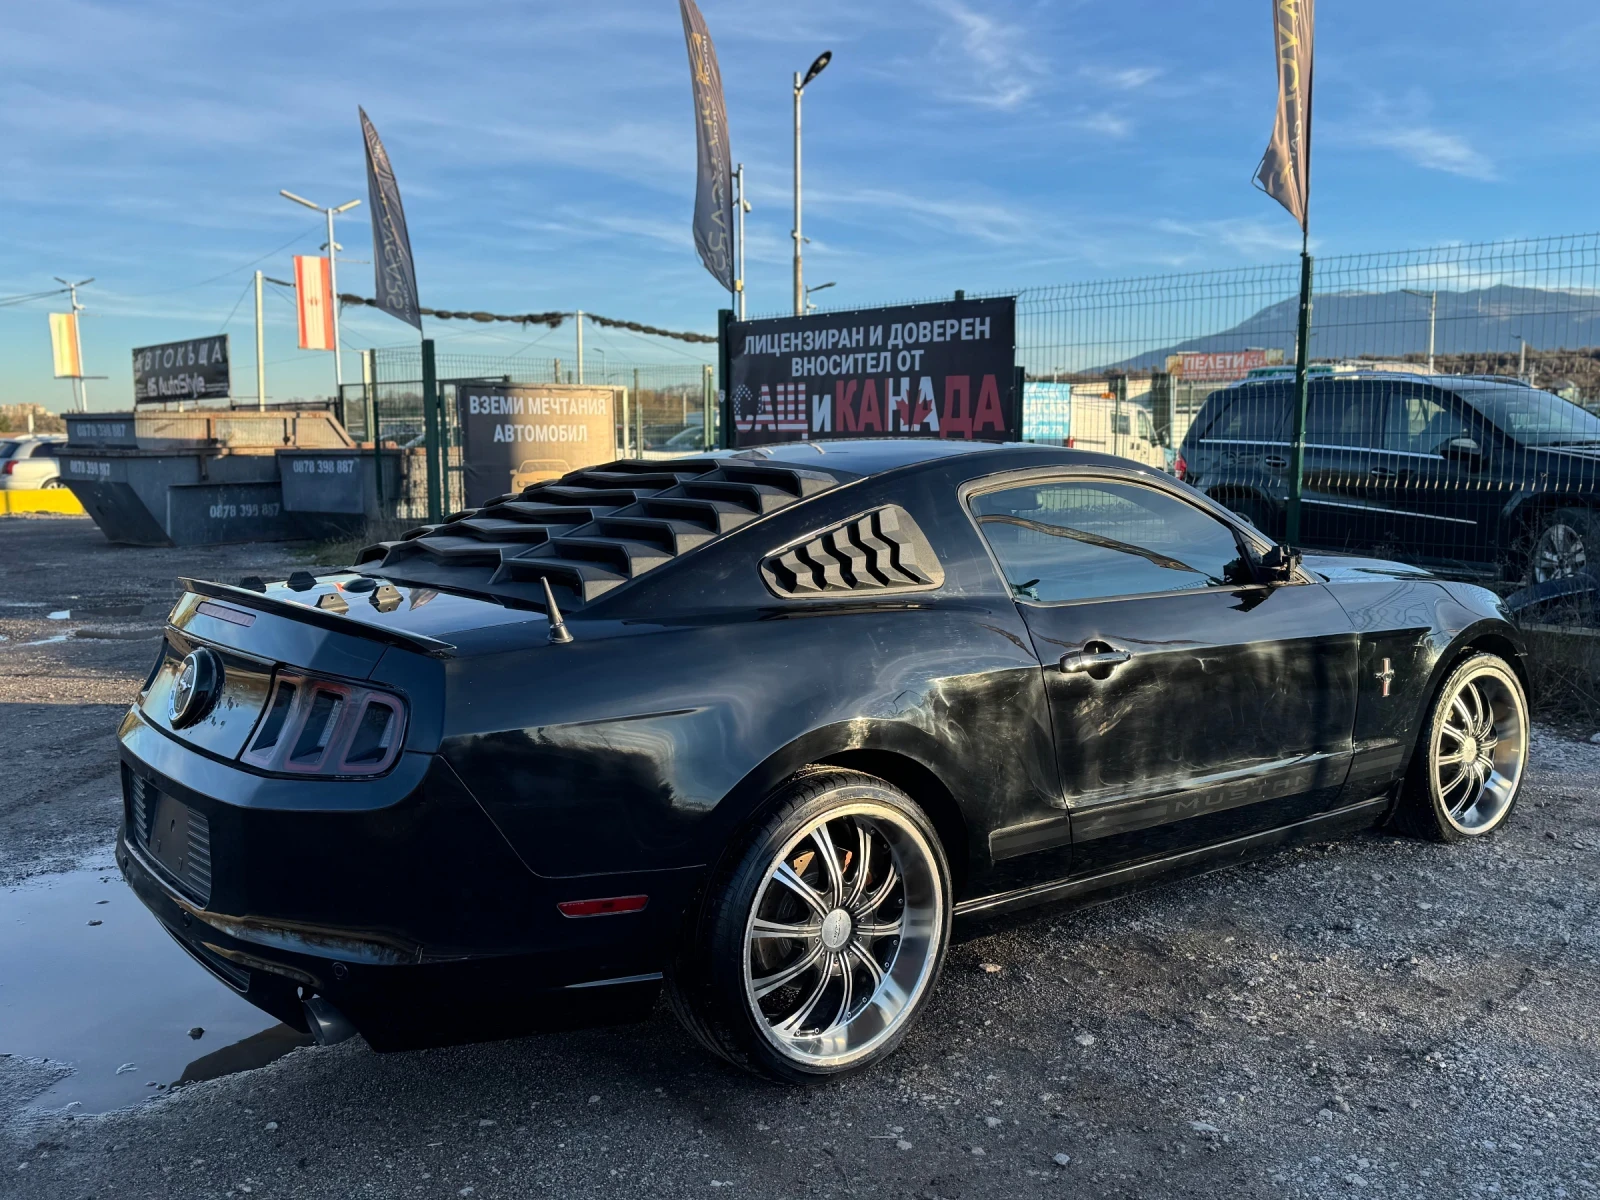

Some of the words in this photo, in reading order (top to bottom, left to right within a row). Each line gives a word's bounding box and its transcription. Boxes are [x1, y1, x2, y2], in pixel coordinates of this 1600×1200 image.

[743, 326, 864, 357] ЛИЦЕНЗИРАН
[869, 324, 883, 346] И
[887, 316, 991, 350] ДОВЕРЕН
[791, 351, 891, 377] ВНОСИТЕЛ
[897, 349, 925, 371] ОТ
[1183, 354, 1246, 370] ПЕЛЕТИ
[469, 395, 524, 415] ВЗЕМИ
[528, 397, 607, 416] МЕЧТАНИЯ
[733, 382, 809, 440] САЩ
[835, 373, 1005, 439] КАНАДА
[493, 423, 588, 443] АВТОМОБИЛ
[293, 460, 315, 473] 0878
[317, 460, 335, 473] 398
[336, 460, 354, 474] 887
[210, 504, 237, 518] 0878
[1174, 773, 1318, 813] MUSTAN
